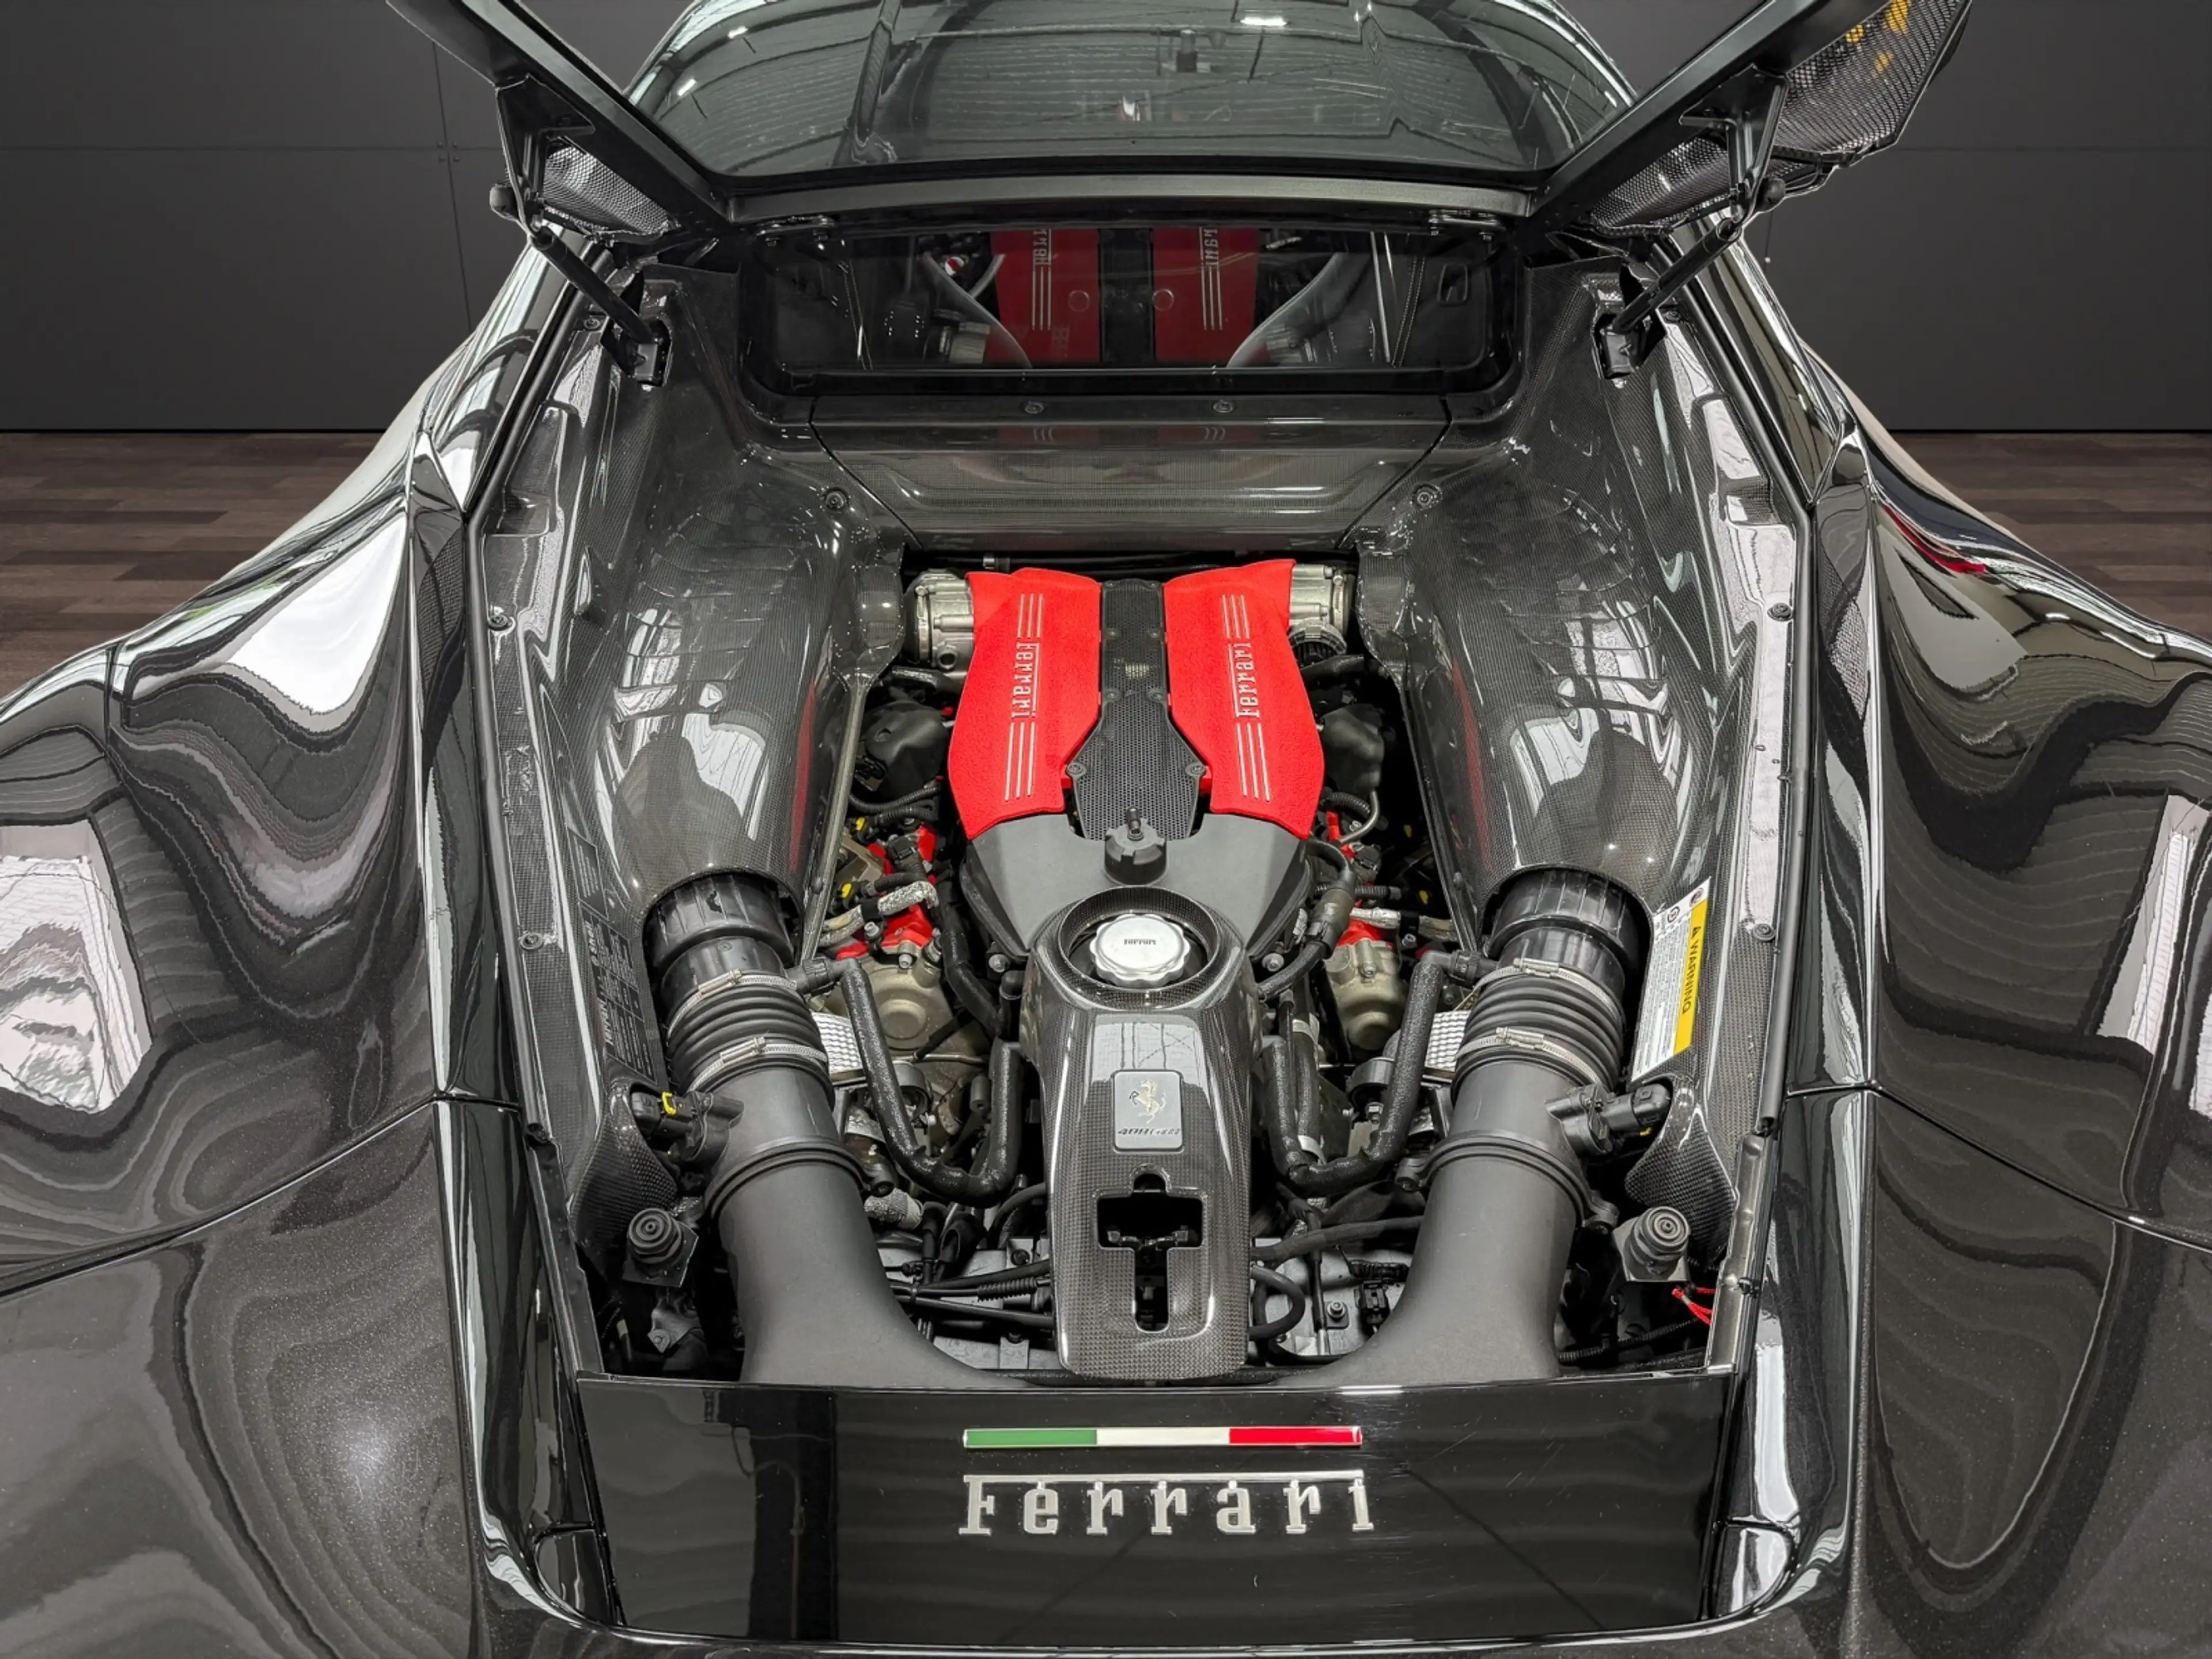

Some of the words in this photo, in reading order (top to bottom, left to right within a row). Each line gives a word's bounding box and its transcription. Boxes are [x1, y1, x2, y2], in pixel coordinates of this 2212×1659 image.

[1012, 642, 1040, 718] Ferrari
[1228, 642, 1260, 718] Ferrari
[1682, 940, 1699, 1014] WARNING
[959, 1469, 1374, 1535] Ferrari
